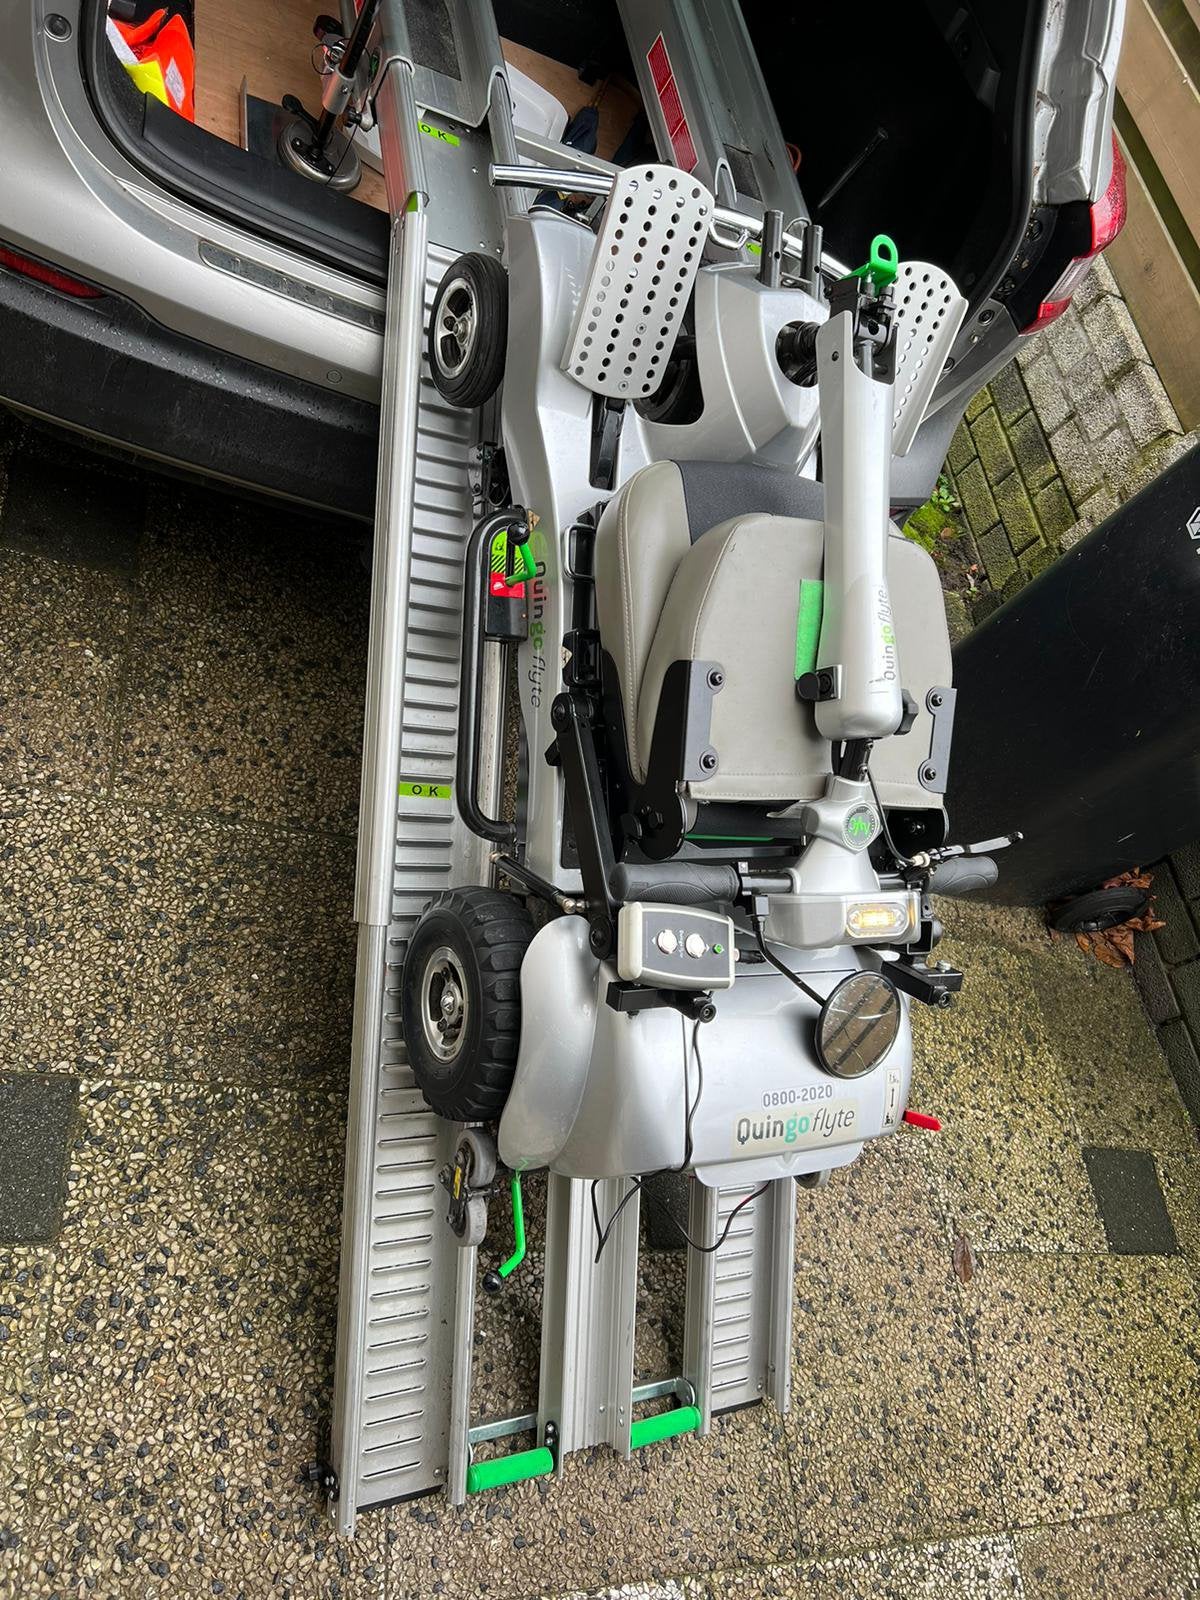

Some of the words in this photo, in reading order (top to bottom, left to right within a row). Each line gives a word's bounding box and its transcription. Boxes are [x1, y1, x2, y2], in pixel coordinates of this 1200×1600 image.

[763, 1084, 832, 1107] 0800-2020
[737, 1112, 810, 1145] Quingo
[812, 1107, 855, 1138] flyte
